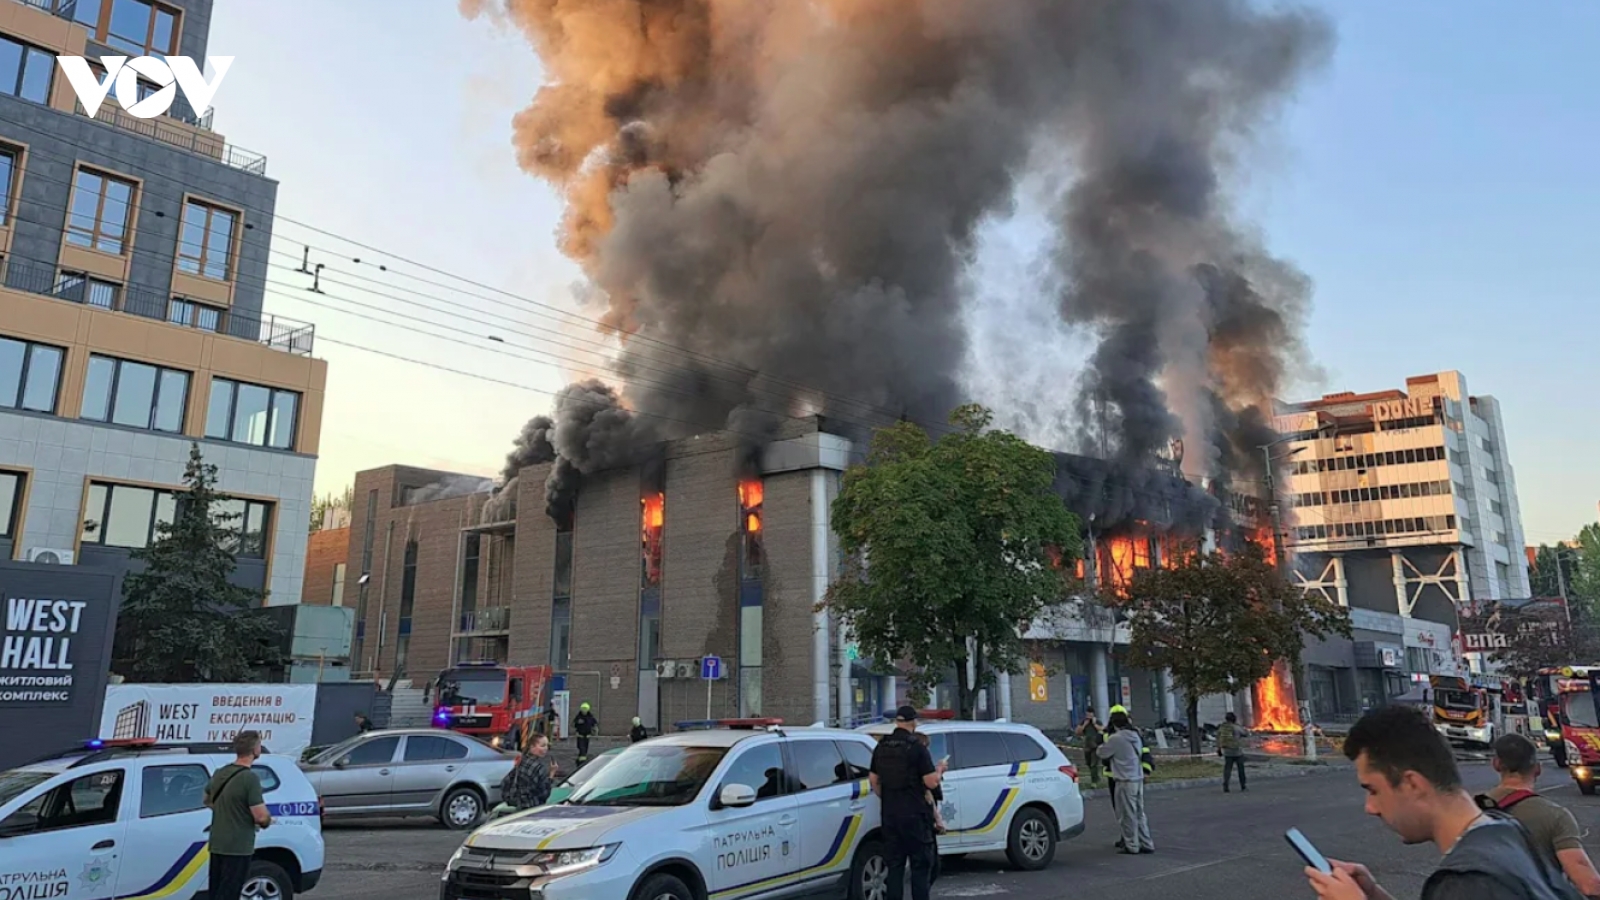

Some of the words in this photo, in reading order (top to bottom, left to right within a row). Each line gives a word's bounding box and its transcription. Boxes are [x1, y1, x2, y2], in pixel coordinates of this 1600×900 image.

[6, 598, 87, 633] WEST
[0, 635, 73, 669] HALL
[212, 696, 273, 707] ВВЕДЕННЯ
[275, 696, 283, 706] В
[159, 704, 199, 719] WEST
[209, 712, 296, 725] ЕКСПЛУАТАЦІЮ
[155, 724, 191, 740] HALL
[294, 803, 315, 815] 102
[714, 825, 775, 848] ПАТРУЛЬНА
[717, 844, 770, 871] ПОЛІЦІЯ
[0, 868, 67, 885] ТРУЛЬНА
